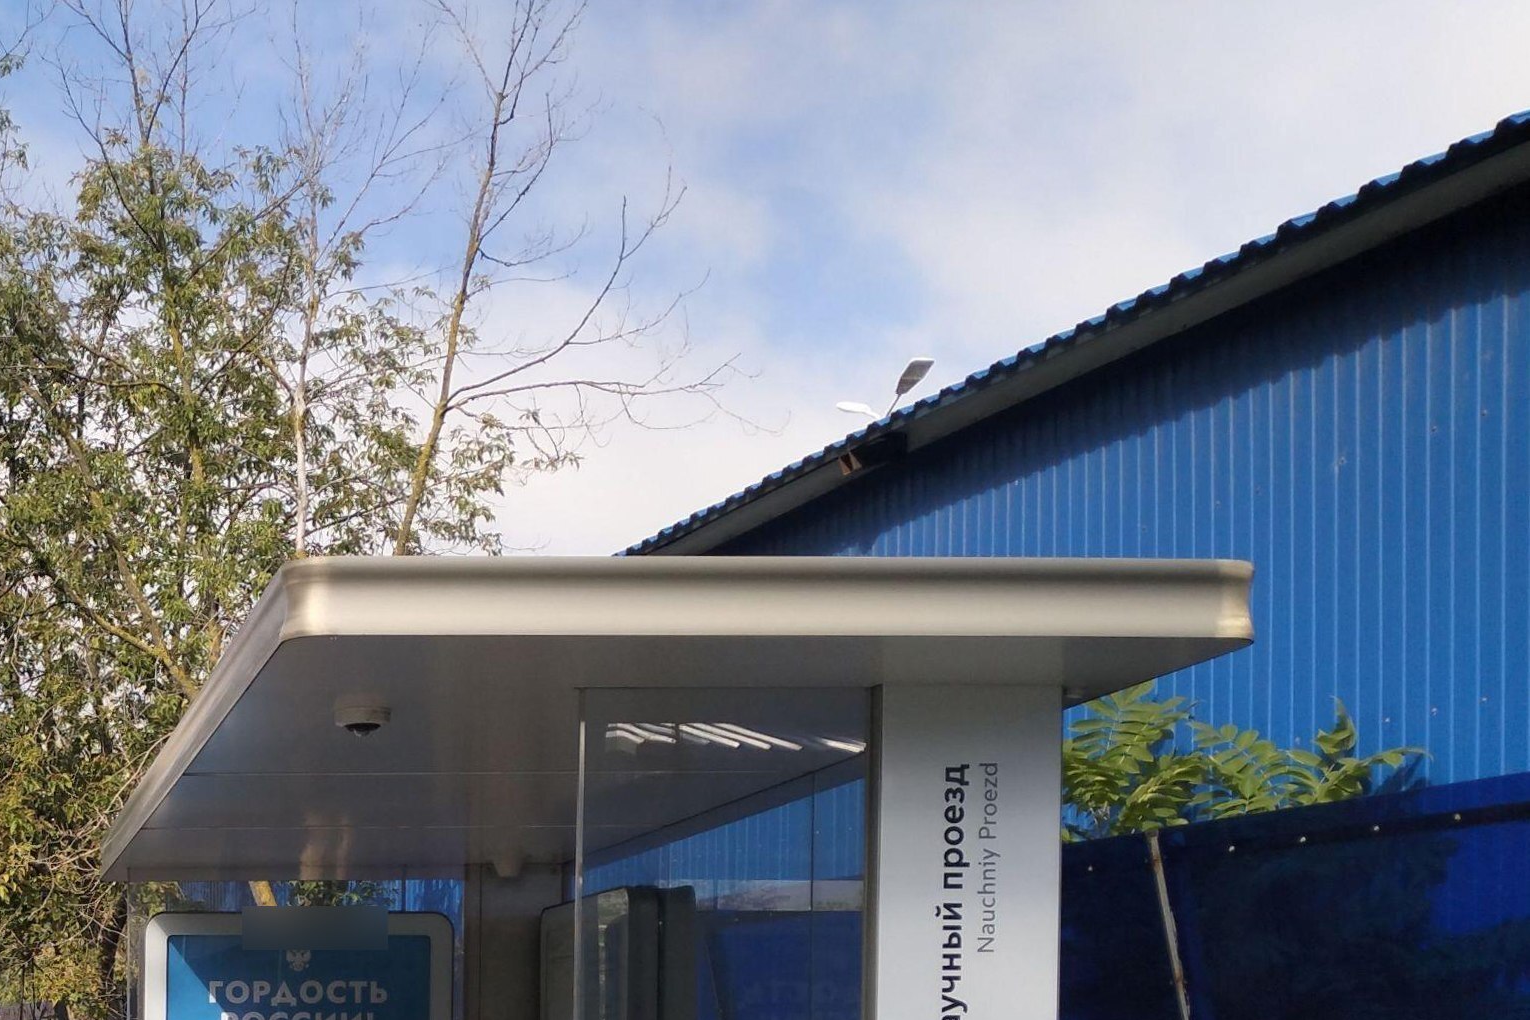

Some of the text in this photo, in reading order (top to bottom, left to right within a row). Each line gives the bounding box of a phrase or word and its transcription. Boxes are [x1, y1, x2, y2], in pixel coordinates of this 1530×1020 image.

[943, 763, 970, 889] проезд
[977, 762, 1001, 953] Nauchniy Proezd
[208, 980, 388, 1006] ГОРДОСТЬ
